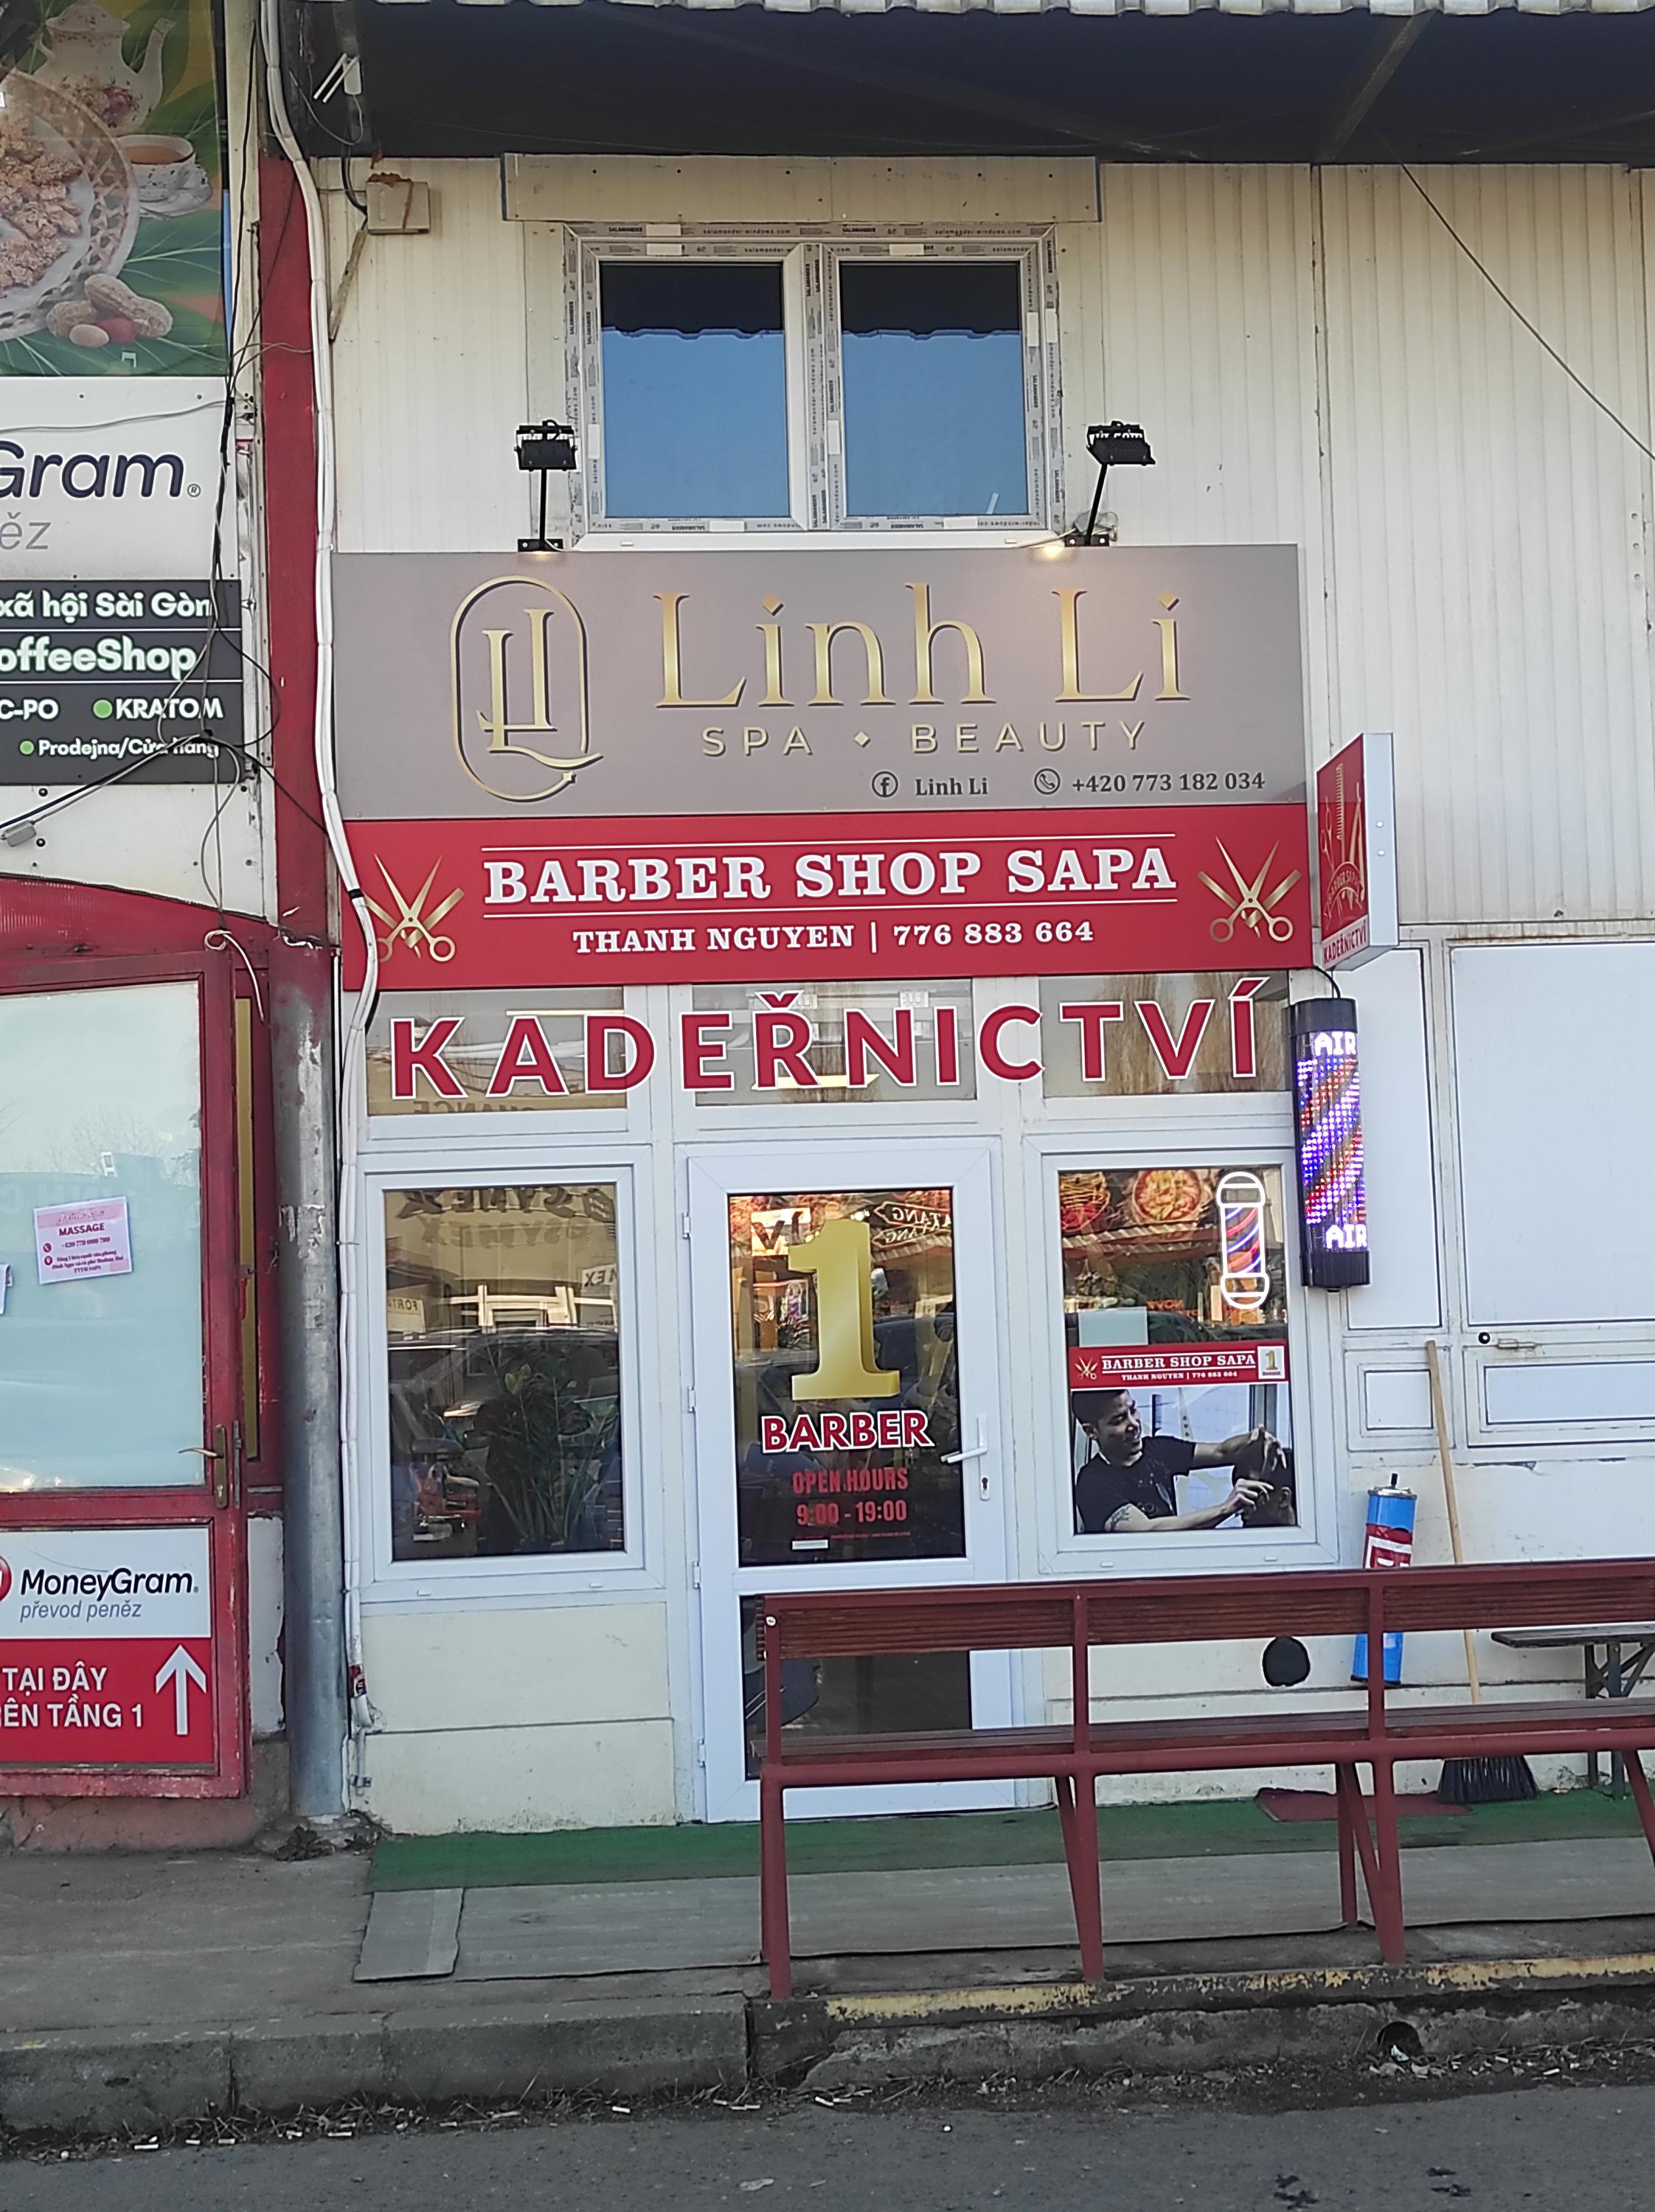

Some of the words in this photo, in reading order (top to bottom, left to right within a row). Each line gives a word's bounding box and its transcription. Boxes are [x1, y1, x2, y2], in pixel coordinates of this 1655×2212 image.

[43, 590, 88, 623] hội
[96, 590, 144, 618] Sài
[151, 591, 212, 618] Gòn
[0, 635, 198, 681] offeeShop
[653, 582, 997, 708] Linh
[1052, 589, 1191, 703] Li
[115, 698, 223, 720] KRATOM
[701, 726, 813, 757] SPA
[911, 719, 1146, 754] BEAUTY
[915, 776, 962, 796] Linh
[968, 776, 988, 796] Li
[1072, 773, 1126, 793] +420
[1131, 773, 1172, 792] 773
[1179, 772, 1218, 790] 182
[1225, 771, 1266, 790] 034
[483, 855, 771, 905] BARBER
[795, 851, 981, 898] SHOP
[1007, 847, 1176, 893] SAPA
[572, 928, 695, 953] THANH
[707, 925, 854, 950] NGUYEN
[893, 924, 952, 947] 776
[964, 922, 1023, 944] 883
[1035, 921, 1094, 942] 664
[1324, 919, 1366, 964] KADEŘNICTVÍ
[390, 975, 1271, 1099] KADEŘNICTVÍ
[59, 1222, 105, 1236] MASSAGE
[788, 1218, 901, 1400] 1
[1102, 1357, 1165, 1370] BARBER
[1170, 1355, 1212, 1368] SHOP
[1217, 1354, 1255, 1366] SAPA
[1265, 1350, 1278, 1371] 1
[761, 1409, 936, 1453] BARBER
[792, 1470, 842, 1495] OPEN
[846, 1467, 909, 1492] HOURS
[797, 1503, 839, 1526] 9:00
[856, 1500, 907, 1523] 19:00
[21, 1568, 193, 1601] MoneyGram
[20, 1600, 82, 1623] převod
[86, 1600, 142, 1622] peněz
[2, 1667, 44, 1696] TẠI
[52, 1660, 108, 1691] ĐÂY
[0, 1697, 38, 1727] ÊN
[131, 1704, 142, 1727] 1
